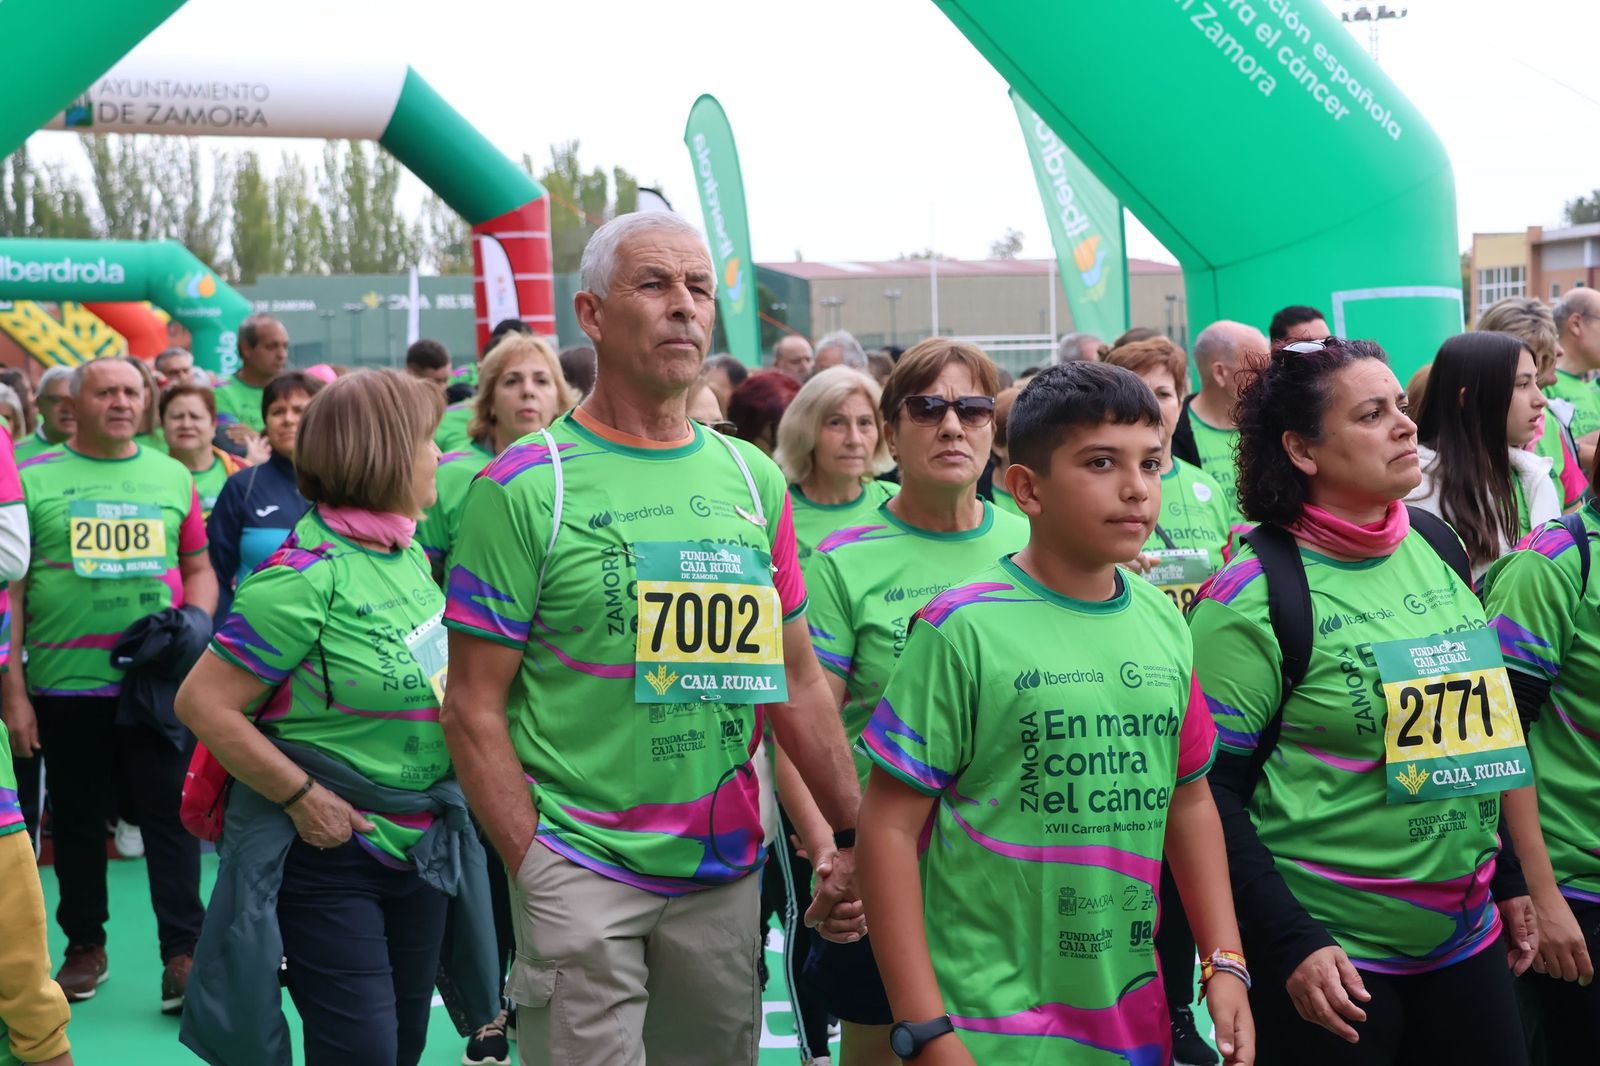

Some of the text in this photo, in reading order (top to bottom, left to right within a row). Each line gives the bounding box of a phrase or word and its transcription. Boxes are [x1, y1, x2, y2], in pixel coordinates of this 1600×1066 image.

[1190, 2, 1278, 97] Zamora
[1255, 22, 1282, 49] el
[1277, 46, 1351, 120] cáncer
[100, 78, 270, 103] AYUNTAMIENTO
[1313, 42, 1402, 140] española
[99, 102, 269, 128] DE ZAMORA
[0, 256, 125, 284] Iberdrola
[614, 504, 675, 523] Iberdrola
[76, 521, 150, 552] 2008
[680, 561, 744, 574] CAJA RURAL
[601, 544, 625, 637] ZAMORA
[645, 592, 760, 654] 7002
[1414, 651, 1471, 668] CAJA RURAL
[1427, 665, 1451, 675] ZAMORA
[403, 667, 427, 690] el
[681, 675, 778, 690] CAJA RURAL
[1044, 669, 1104, 686] Iberdrola
[1337, 648, 1377, 736] ZAMORA
[1044, 707, 1179, 741] En march
[1397, 675, 1494, 748] 2771
[652, 746, 675, 756] CAJA
[1019, 711, 1039, 813] ZAMORA
[1044, 745, 1148, 777] contra
[1432, 759, 1526, 785] CAJA RURAL
[1043, 782, 1079, 813] el
[1045, 823, 1068, 834] XVII
[1072, 823, 1110, 834] Carrera
[1113, 821, 1146, 832] Mucho
[1409, 825, 1435, 837] CAJA
[1438, 820, 1468, 833] RURAL
[1078, 894, 1114, 909] ZAMORA
[1130, 920, 1152, 946] ga
[1059, 940, 1087, 953] CAJA
[1071, 951, 1098, 960] ZAMORA
